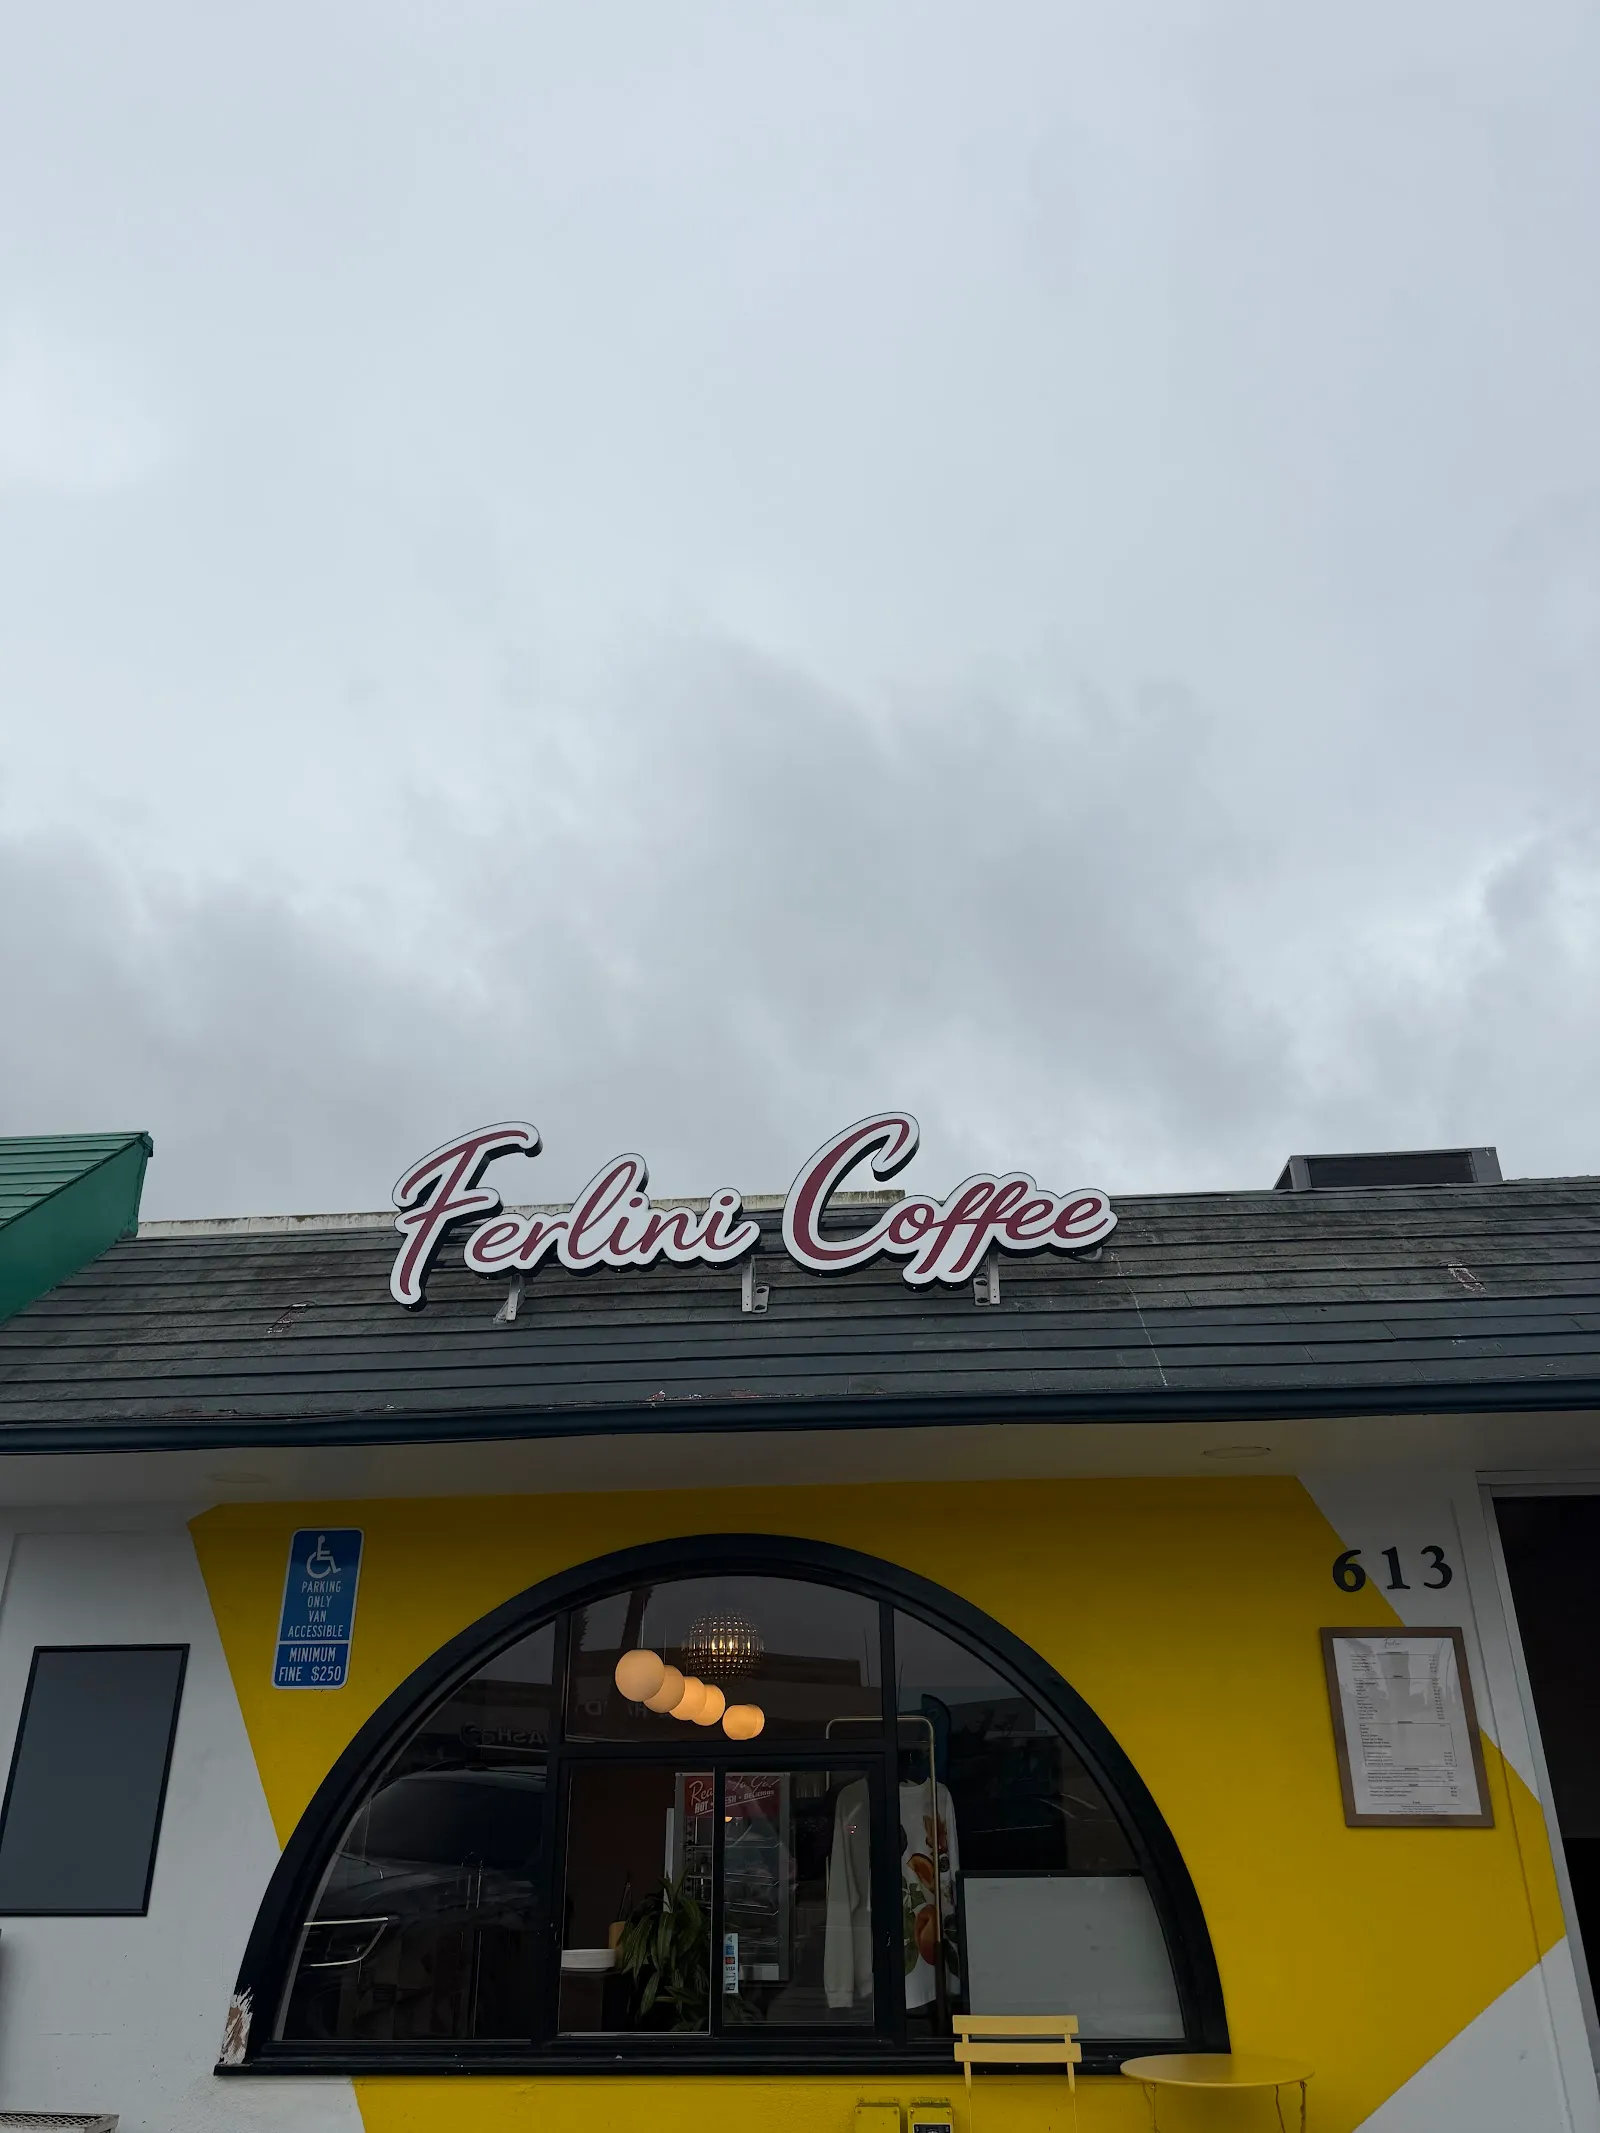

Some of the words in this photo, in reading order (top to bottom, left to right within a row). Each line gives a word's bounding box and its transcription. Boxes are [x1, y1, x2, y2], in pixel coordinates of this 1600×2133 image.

[399, 1128, 754, 1299] Ferlini
[789, 1116, 1109, 1276] Coffee
[1332, 1545, 1453, 1592] 613
[301, 1580, 342, 1593] PARKING
[307, 1595, 332, 1608] ONLY
[308, 1610, 327, 1623] VAN
[287, 1624, 344, 1638] ACCESSIBLE
[289, 1647, 336, 1663] MINIMUM
[278, 1666, 303, 1682] FINE
[310, 1665, 341, 1682] $250
[694, 1800, 709, 1814] HOT
[725, 1795, 737, 1804] ESH
